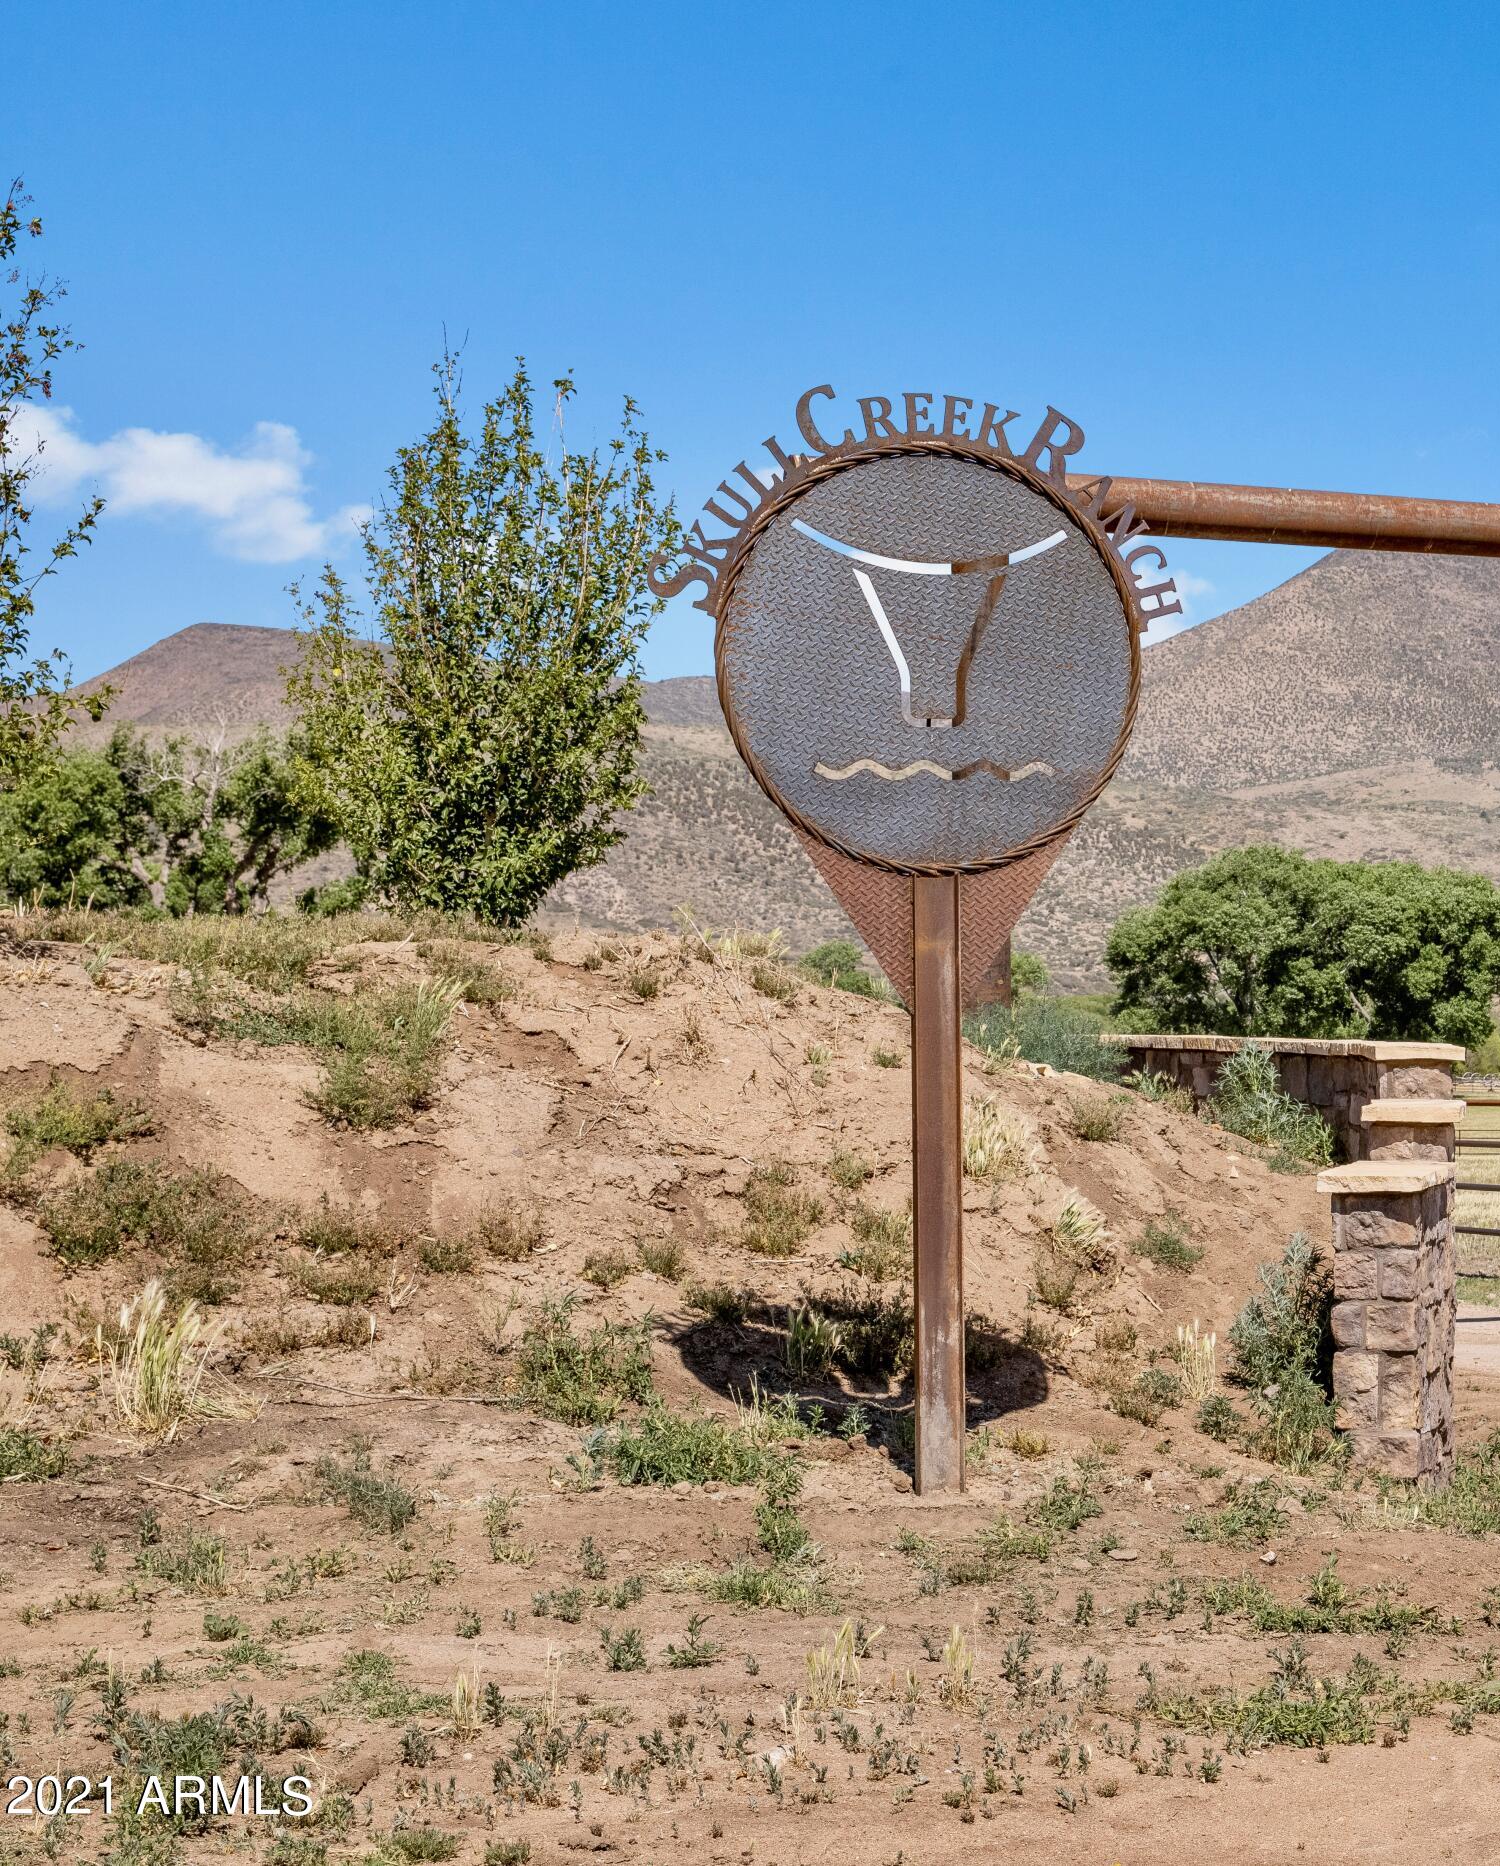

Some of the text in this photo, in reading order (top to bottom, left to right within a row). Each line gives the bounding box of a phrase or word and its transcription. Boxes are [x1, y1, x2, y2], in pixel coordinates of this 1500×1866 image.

[647, 384, 1184, 633] SKULL CREEK RANCH
